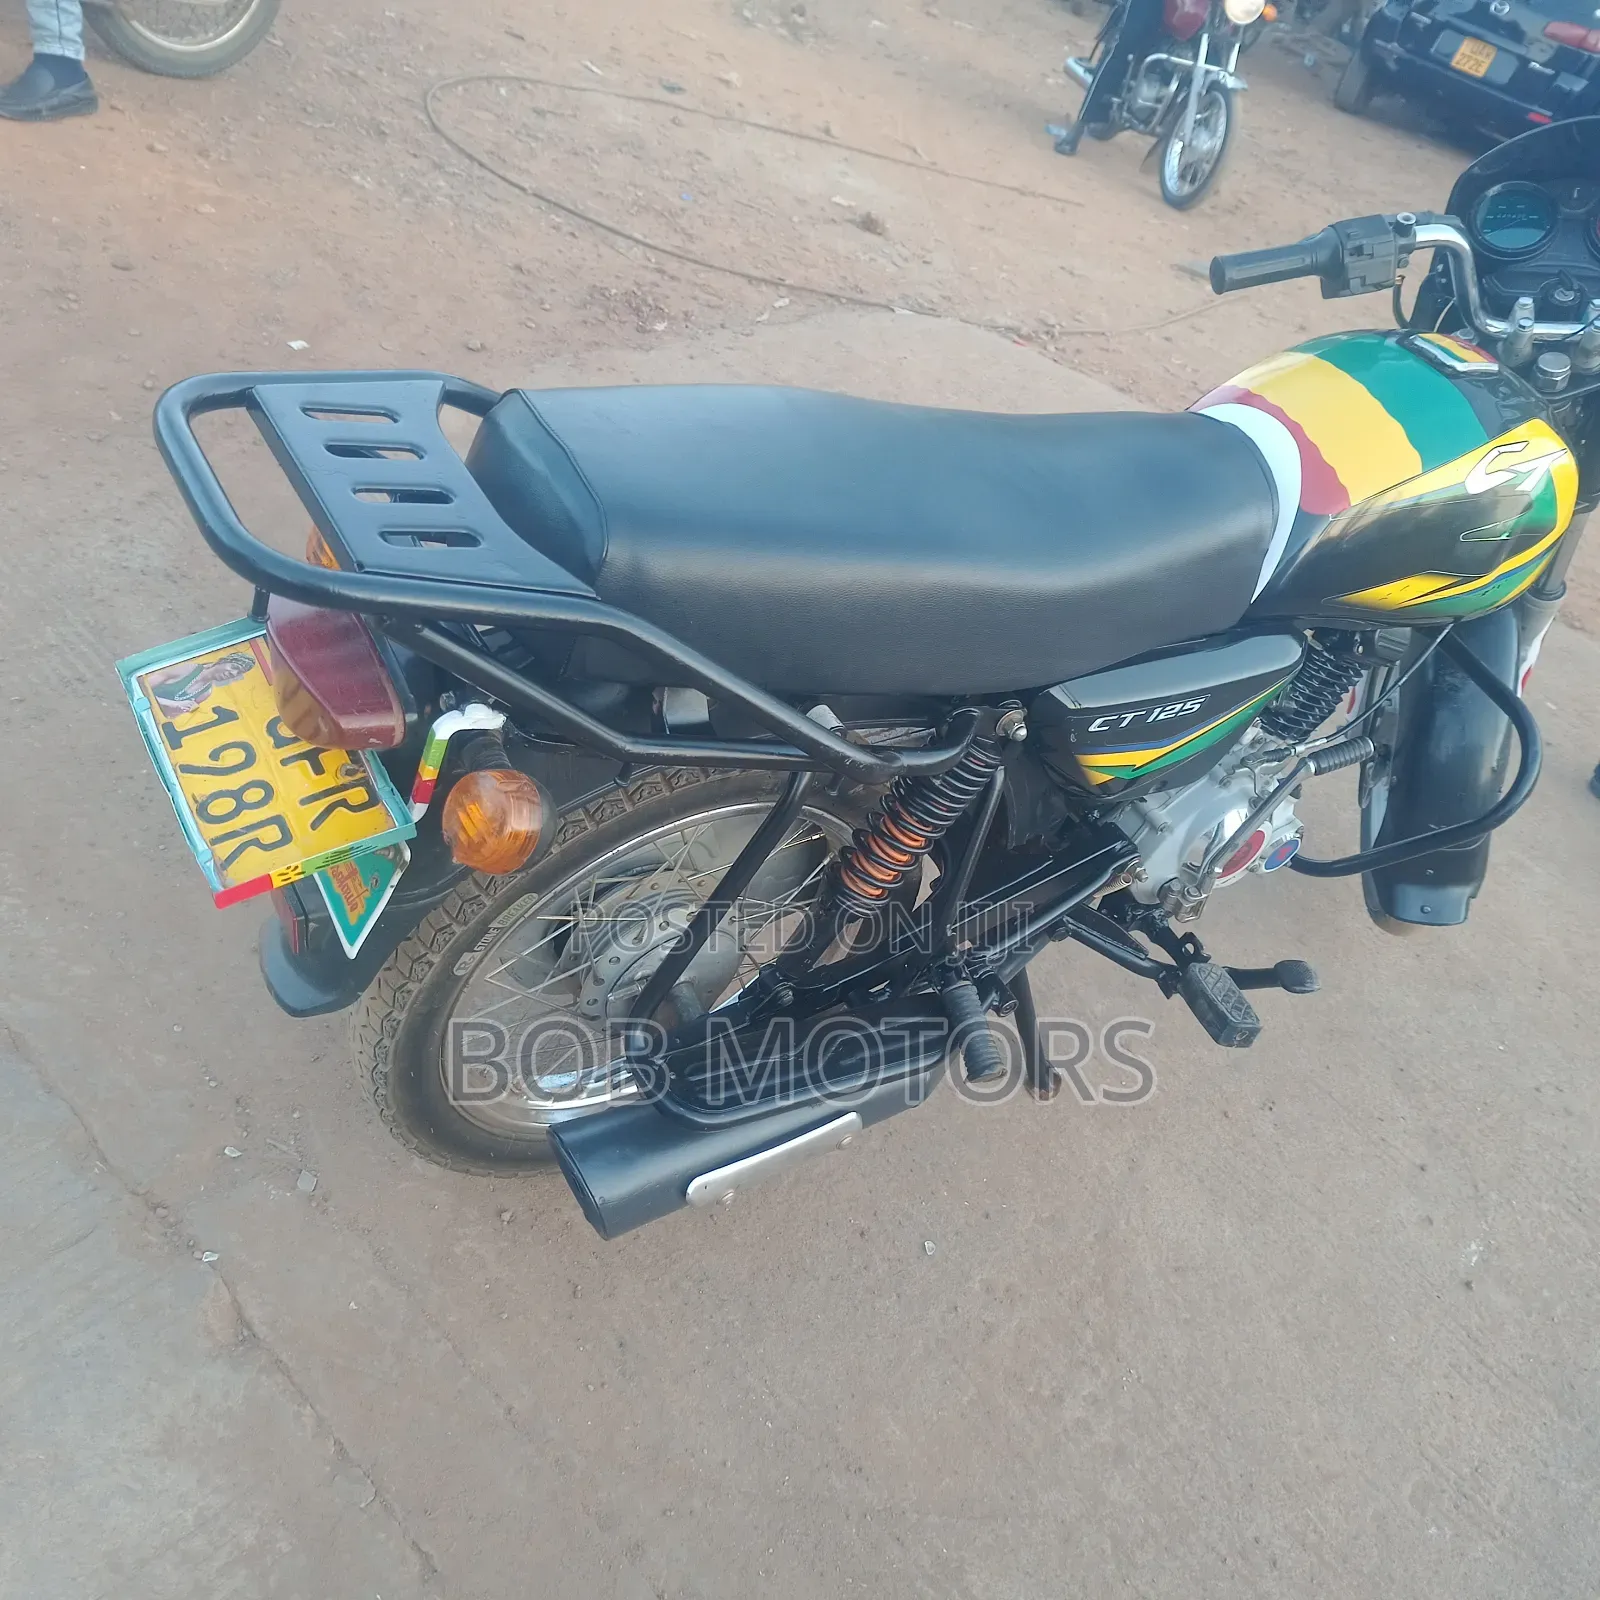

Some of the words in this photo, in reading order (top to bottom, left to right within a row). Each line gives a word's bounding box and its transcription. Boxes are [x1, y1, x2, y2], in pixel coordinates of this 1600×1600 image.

[1088, 710, 1146, 732] CT
[1146, 696, 1208, 724] 125
[162, 705, 293, 871] 198R
[474, 927, 501, 952] STONE
